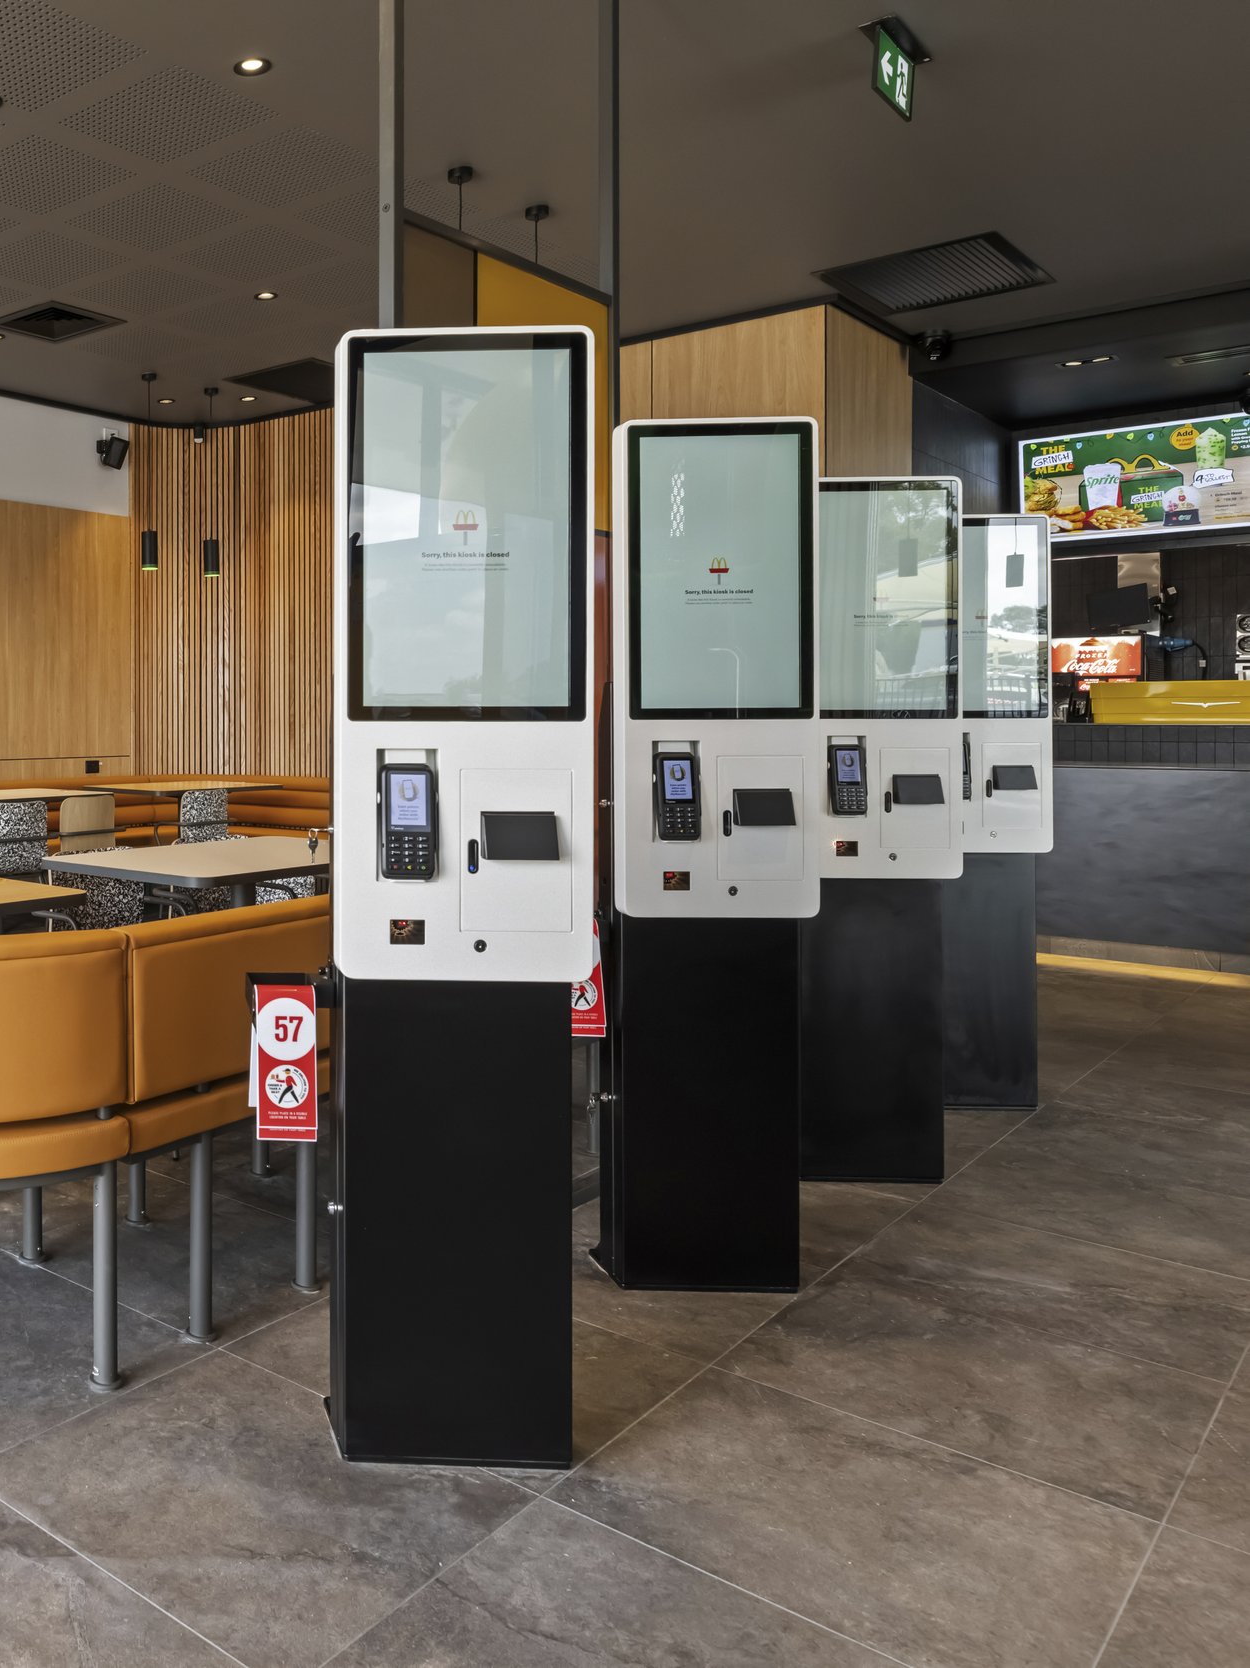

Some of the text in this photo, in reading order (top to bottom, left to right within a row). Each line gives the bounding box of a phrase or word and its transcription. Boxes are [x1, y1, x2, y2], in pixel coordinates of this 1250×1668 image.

[1176, 430, 1193, 438] Add
[1040, 445, 1065, 455] THE
[1035, 463, 1073, 475] MEAL
[1086, 473, 1119, 488] Sprite
[1195, 474, 1204, 484] 4
[1138, 485, 1160, 494] THE
[421, 551, 442, 559] Sorry,
[1061, 658, 1120, 675] Coca-Cola
[275, 1016, 303, 1042] 57
